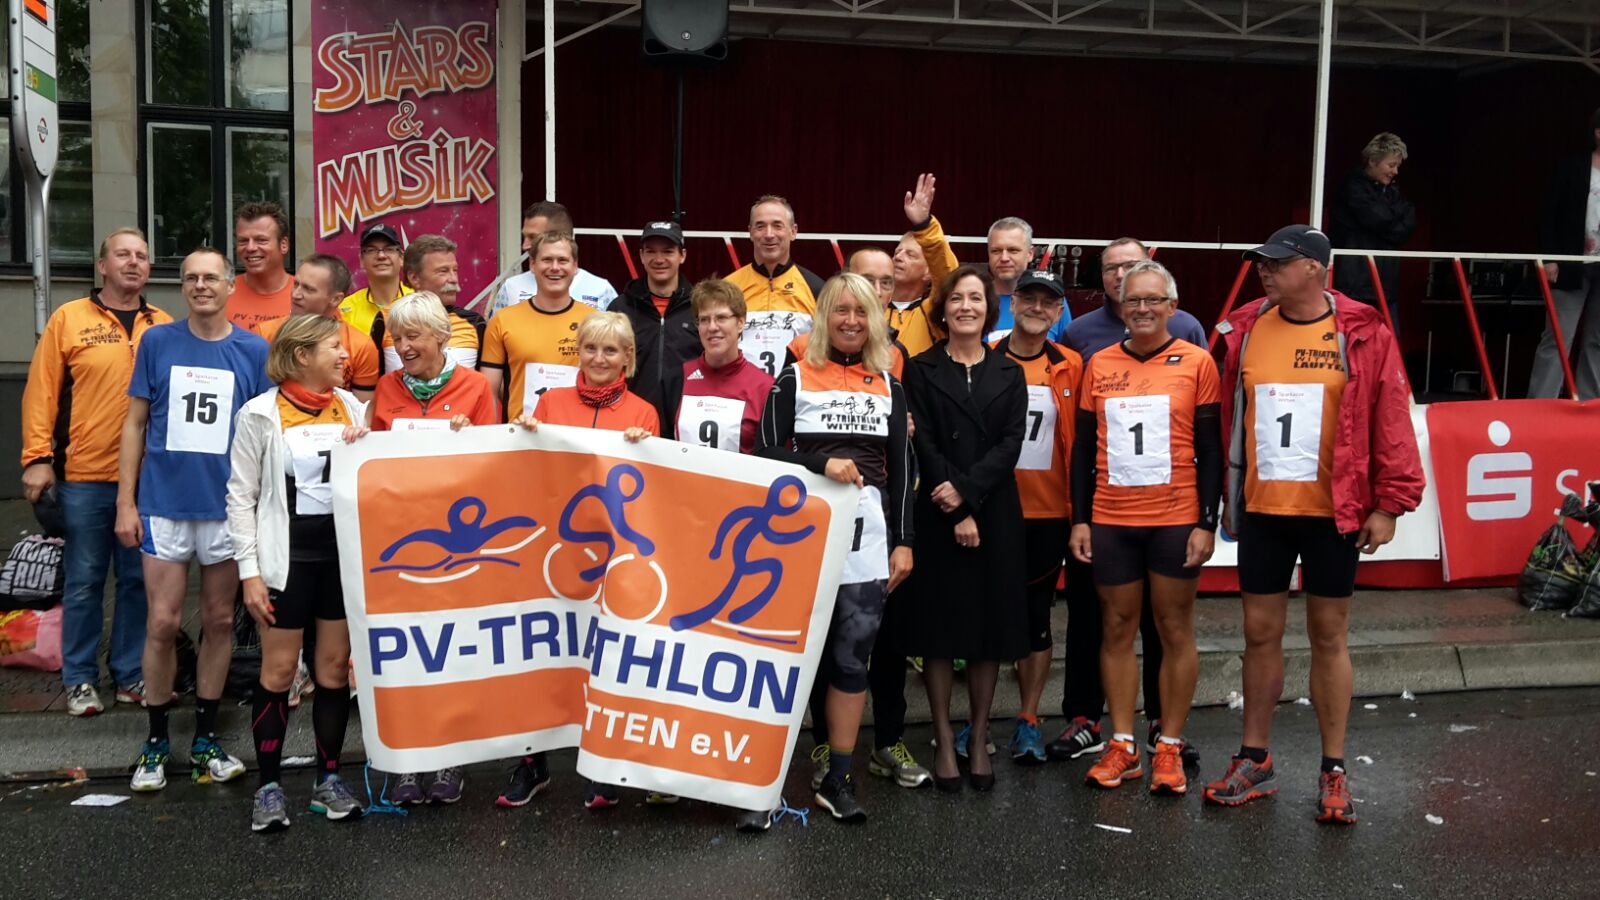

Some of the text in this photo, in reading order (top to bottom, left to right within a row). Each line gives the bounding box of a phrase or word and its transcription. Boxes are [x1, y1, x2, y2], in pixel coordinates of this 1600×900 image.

[314, 18, 494, 113] STARS
[387, 100, 424, 141] &
[181, 391, 218, 425] 15
[821, 413, 881, 425] PV-TRIATHLON
[698, 420, 719, 449] 9
[826, 423, 877, 432] WITTEN
[1128, 422, 1144, 455] 1
[1276, 412, 1293, 448] 1
[13, 561, 57, 591] RUN
[584, 696, 752, 765] TTEN e.V.
